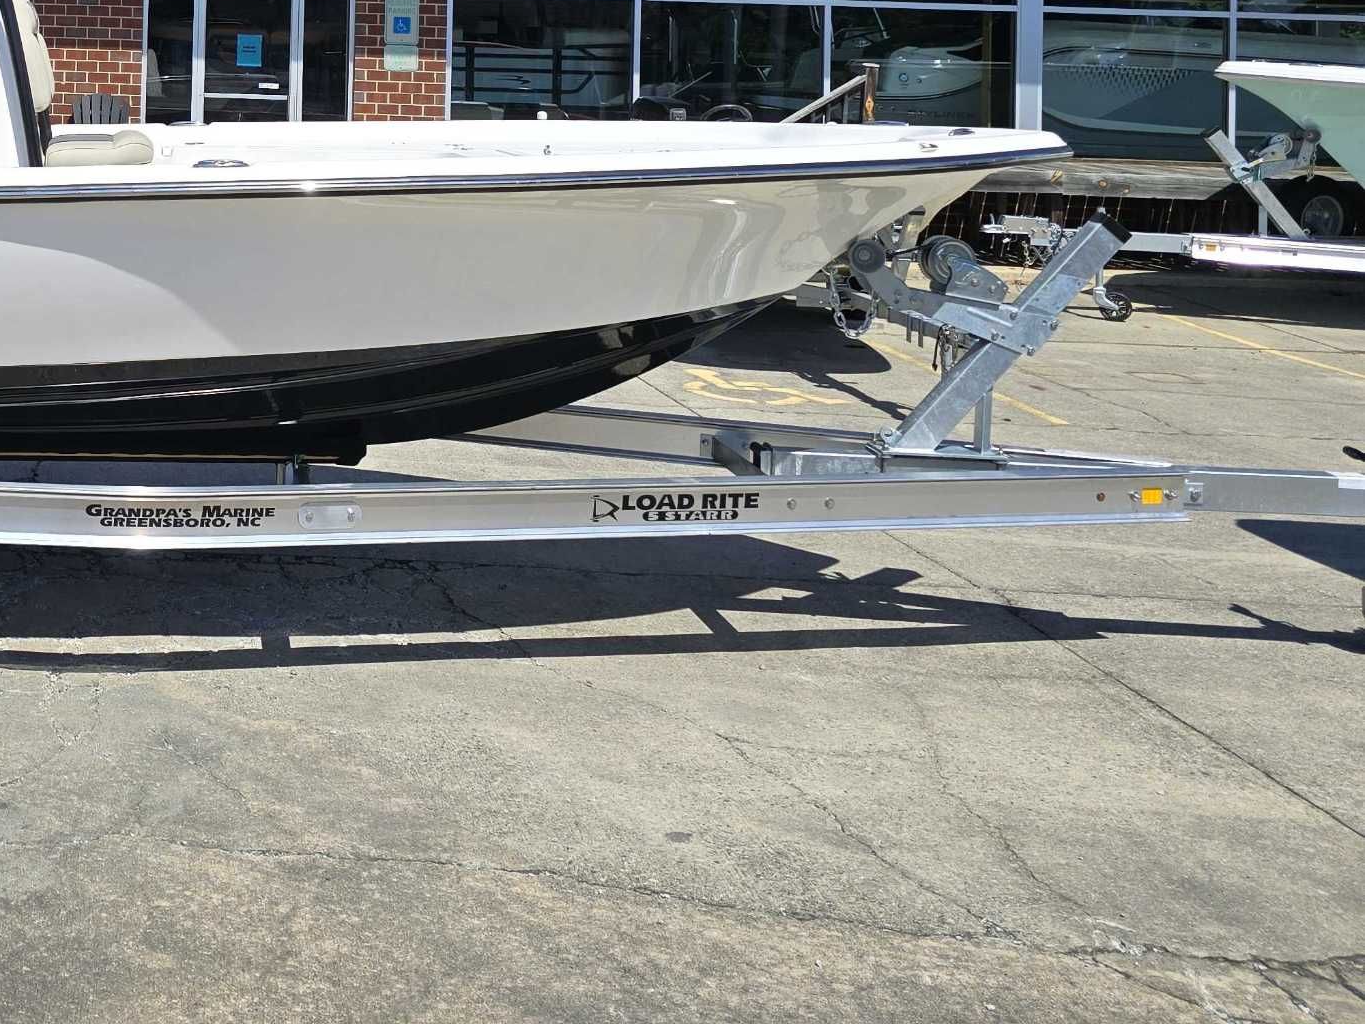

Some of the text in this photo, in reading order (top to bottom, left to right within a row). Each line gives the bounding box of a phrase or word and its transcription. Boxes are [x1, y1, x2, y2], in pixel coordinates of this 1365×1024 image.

[621, 492, 760, 511] LOAD RITE
[85, 504, 276, 518] GRANDPA'S MARINE
[646, 509, 734, 521] 5 STARR
[99, 517, 262, 528] GREENSBORO, NC
